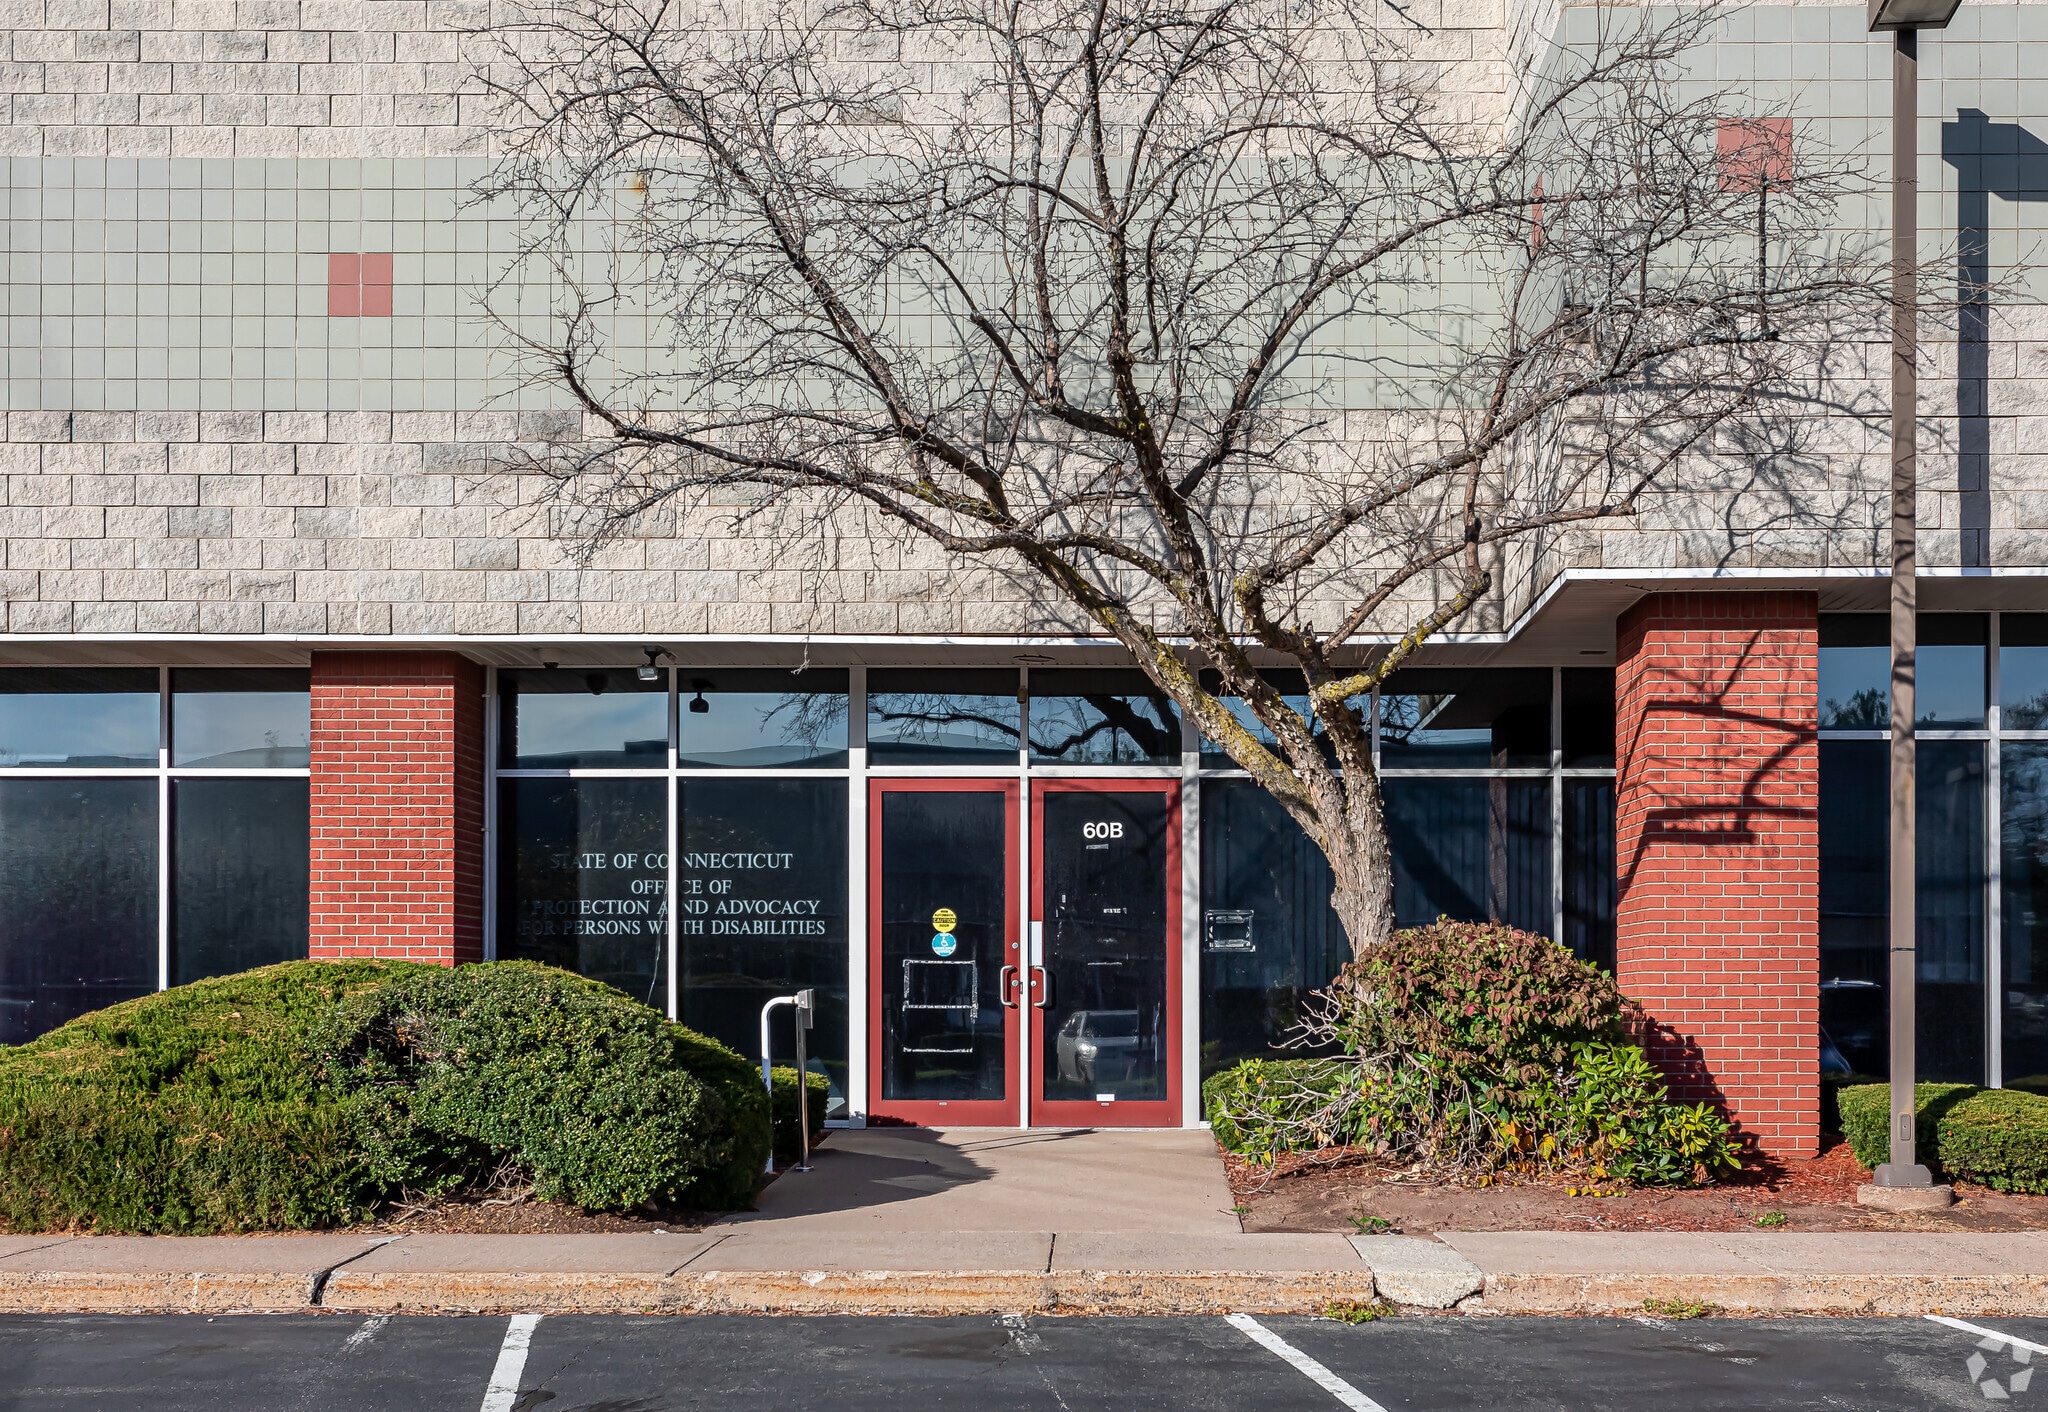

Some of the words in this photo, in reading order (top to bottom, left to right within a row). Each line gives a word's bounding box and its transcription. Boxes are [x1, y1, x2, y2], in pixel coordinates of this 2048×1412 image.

[1083, 822, 1124, 839] 60B
[550, 853, 607, 869] STATE
[613, 853, 638, 869] OF
[644, 853, 794, 869] CONNECTICUT
[709, 879, 733, 895] OF
[531, 900, 650, 915] PROTECTION
[657, 900, 709, 915] AND
[714, 900, 821, 915] ADVOCACY
[563, 920, 641, 935] PERSONS
[647, 920, 705, 935] WITH
[710, 920, 826, 935] DISABILITIES
